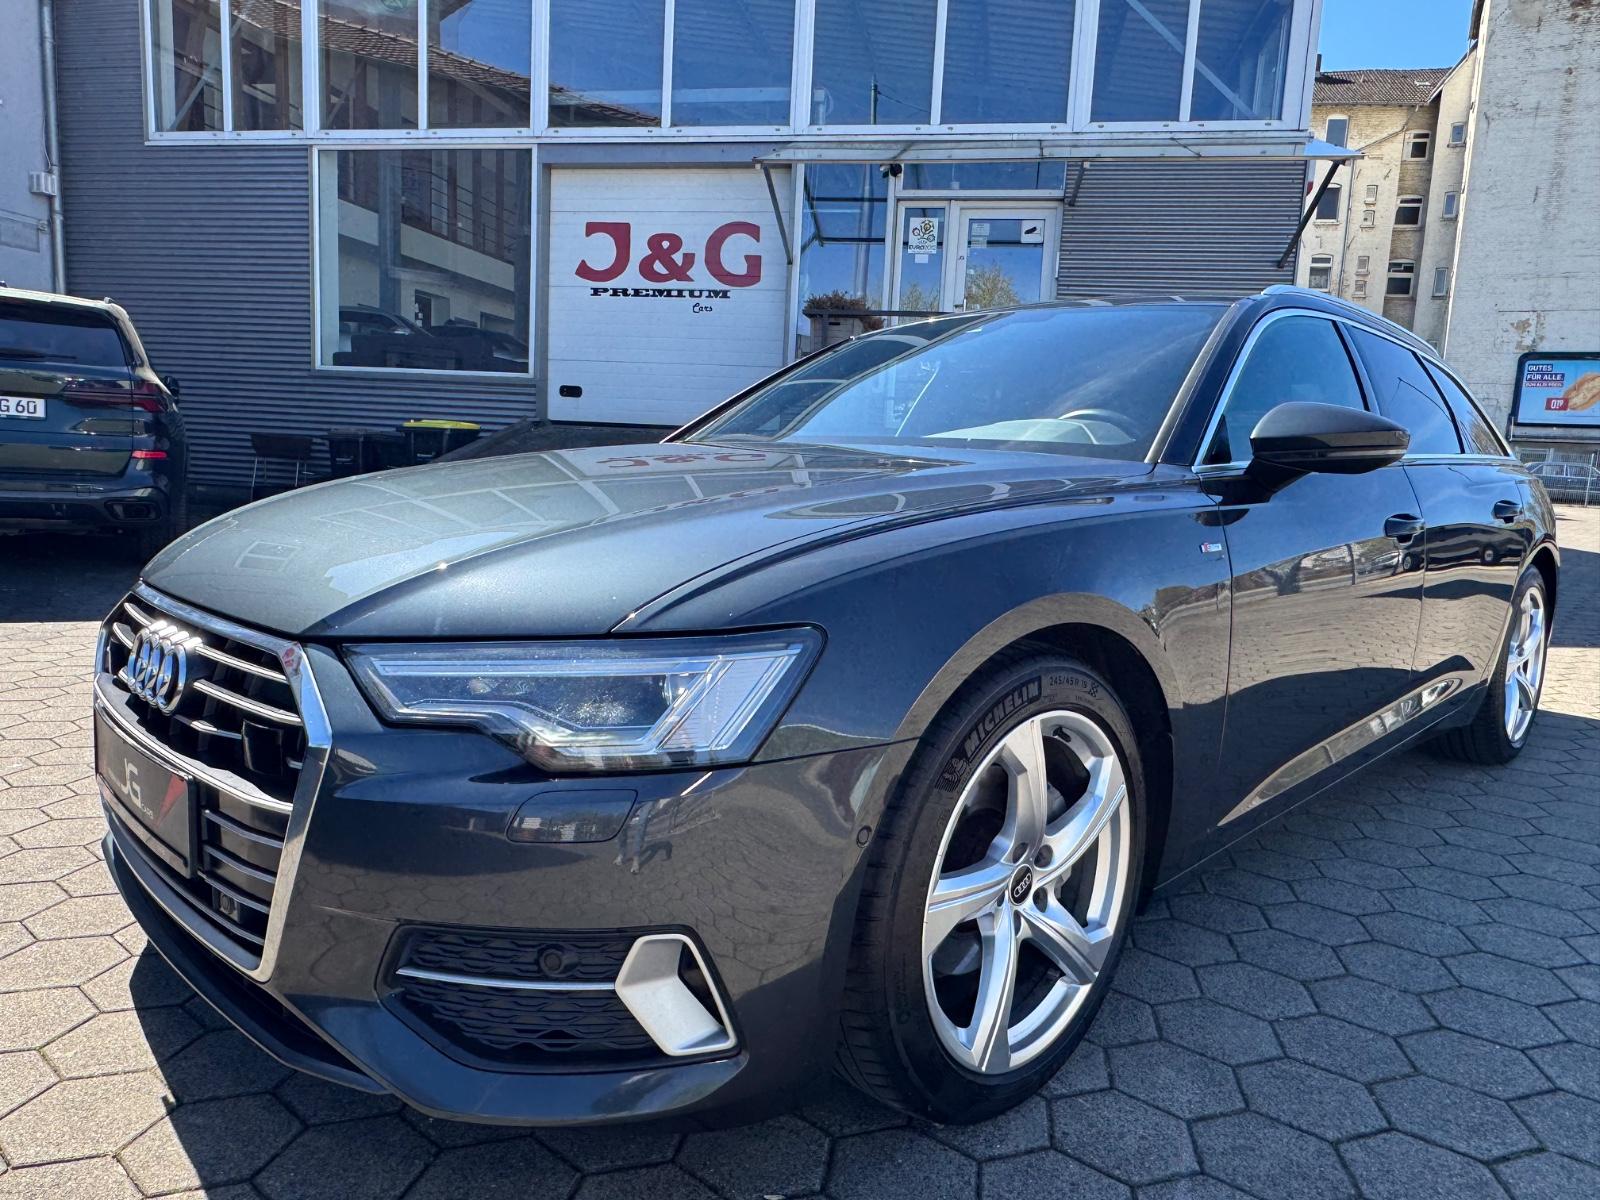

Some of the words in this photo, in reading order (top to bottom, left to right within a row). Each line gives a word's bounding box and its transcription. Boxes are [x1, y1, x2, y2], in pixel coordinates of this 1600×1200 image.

[575, 220, 762, 288] J&G
[590, 287, 731, 299] PREMIUM
[692, 302, 713, 313] Cars
[15, 400, 37, 414] 60
[963, 680, 1040, 756] MICHELIN
